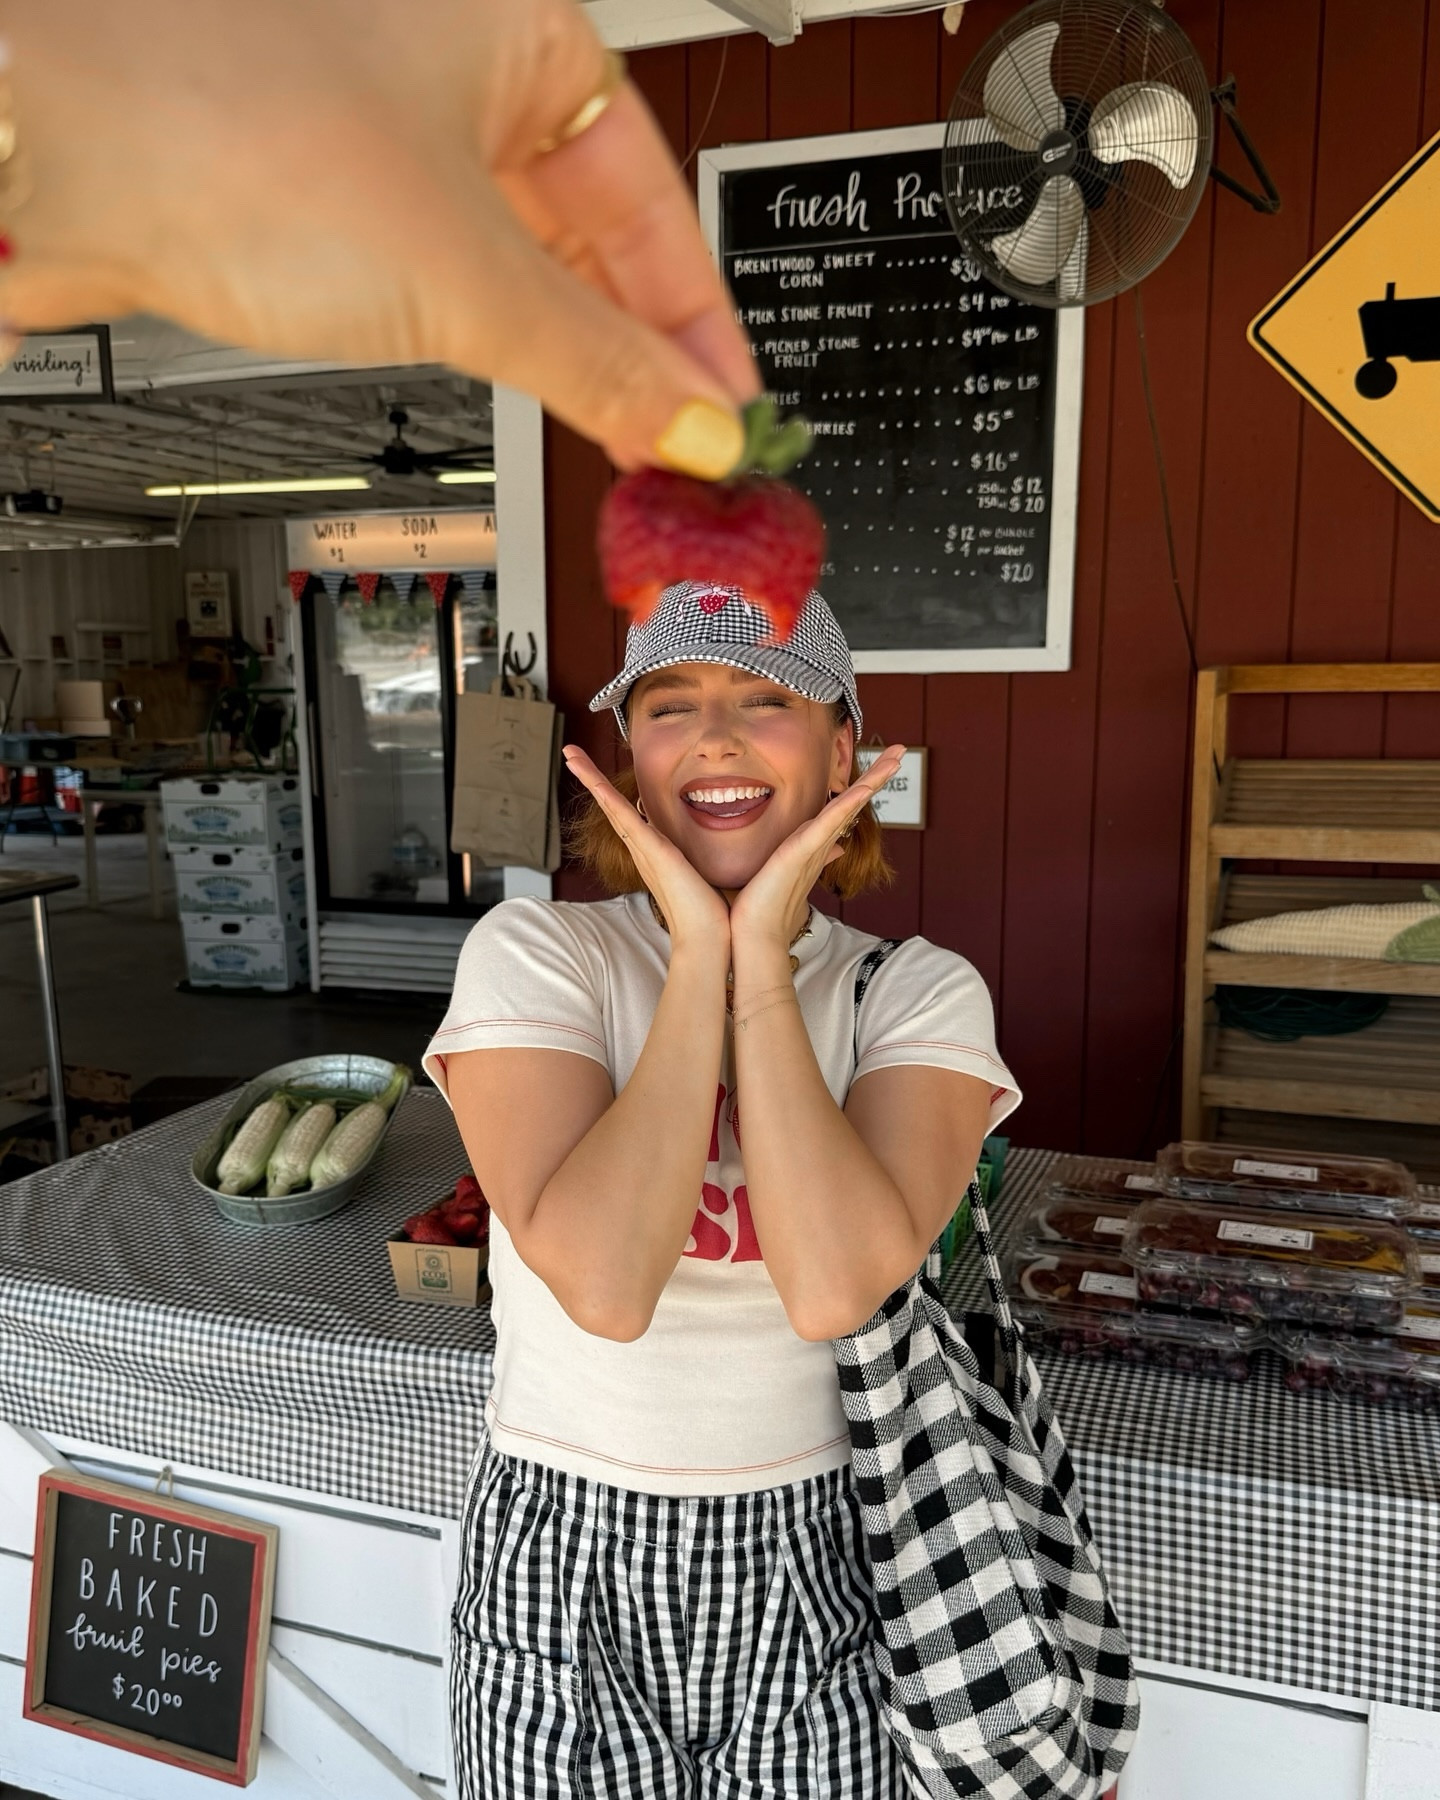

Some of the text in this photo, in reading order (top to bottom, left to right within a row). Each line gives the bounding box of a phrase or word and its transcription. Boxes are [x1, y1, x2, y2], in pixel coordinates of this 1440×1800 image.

[734, 252, 876, 278] BRENTWOOD SWEET
[779, 271, 824, 289] CORN
[781, 304, 821, 322] STONE
[827, 302, 874, 320] FRUIT
[958, 291, 984, 312] $4
[747, 338, 810, 356] E-PICKED
[817, 336, 860, 351] STONE
[774, 352, 819, 368] FRUIT
[963, 374, 990, 394] $6
[312, 521, 357, 540] WATER
[401, 518, 438, 536] SODA
[330, 547, 344, 562] $1
[414, 544, 427, 558] $2
[1000, 562, 1034, 583] $20
[108, 1512, 207, 1575] FRESH
[79, 1558, 218, 1637] BAKED
[65, 1613, 222, 1683] fruit pies
